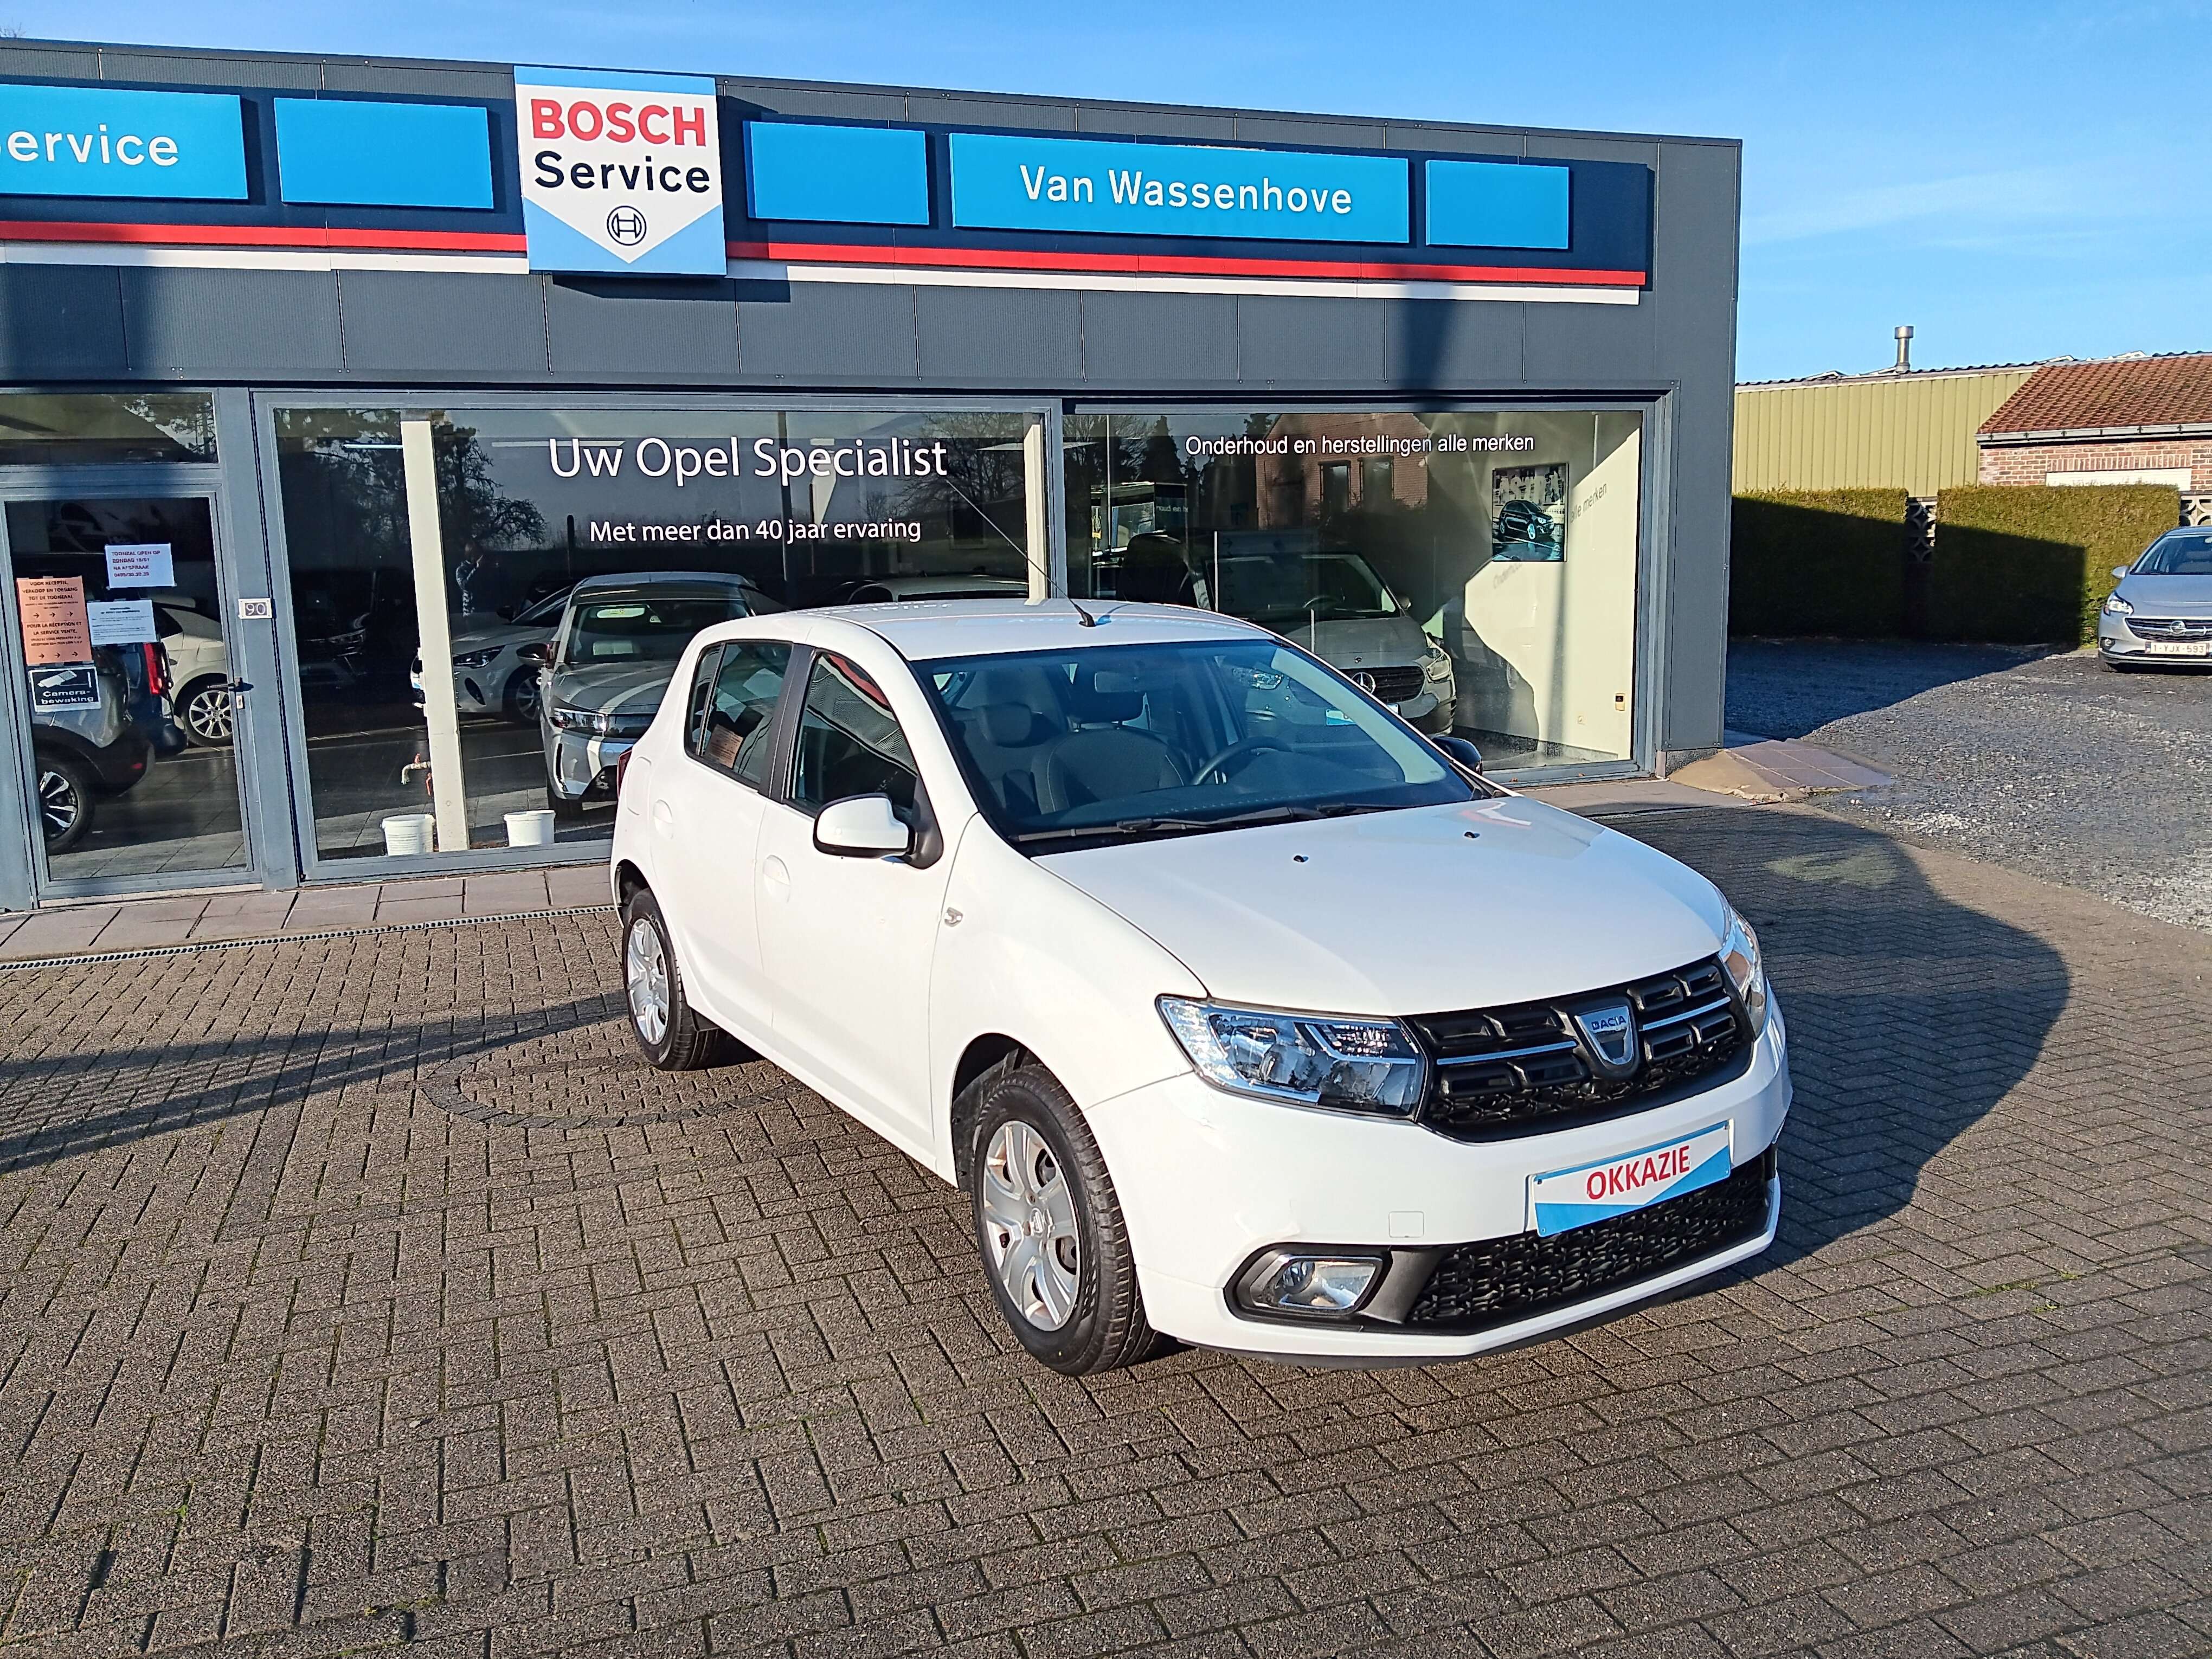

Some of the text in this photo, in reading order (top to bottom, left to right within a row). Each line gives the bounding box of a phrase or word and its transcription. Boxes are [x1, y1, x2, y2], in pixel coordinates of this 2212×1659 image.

[531, 99, 706, 146] BOSCH
[0, 124, 179, 166] ervice
[535, 151, 710, 193] Service
[1020, 164, 1352, 215] Van Wassenhove
[549, 436, 948, 487] Uw Opel Specialist
[1186, 434, 1534, 457] Onderhoud en herstellingen alle merken
[589, 518, 921, 544] Met meer dan 40 jaar ervaring
[247, 603, 265, 615] 90
[1591, 1015, 1626, 1030] DACIA
[1586, 1145, 1690, 1200] OKKAZIE
